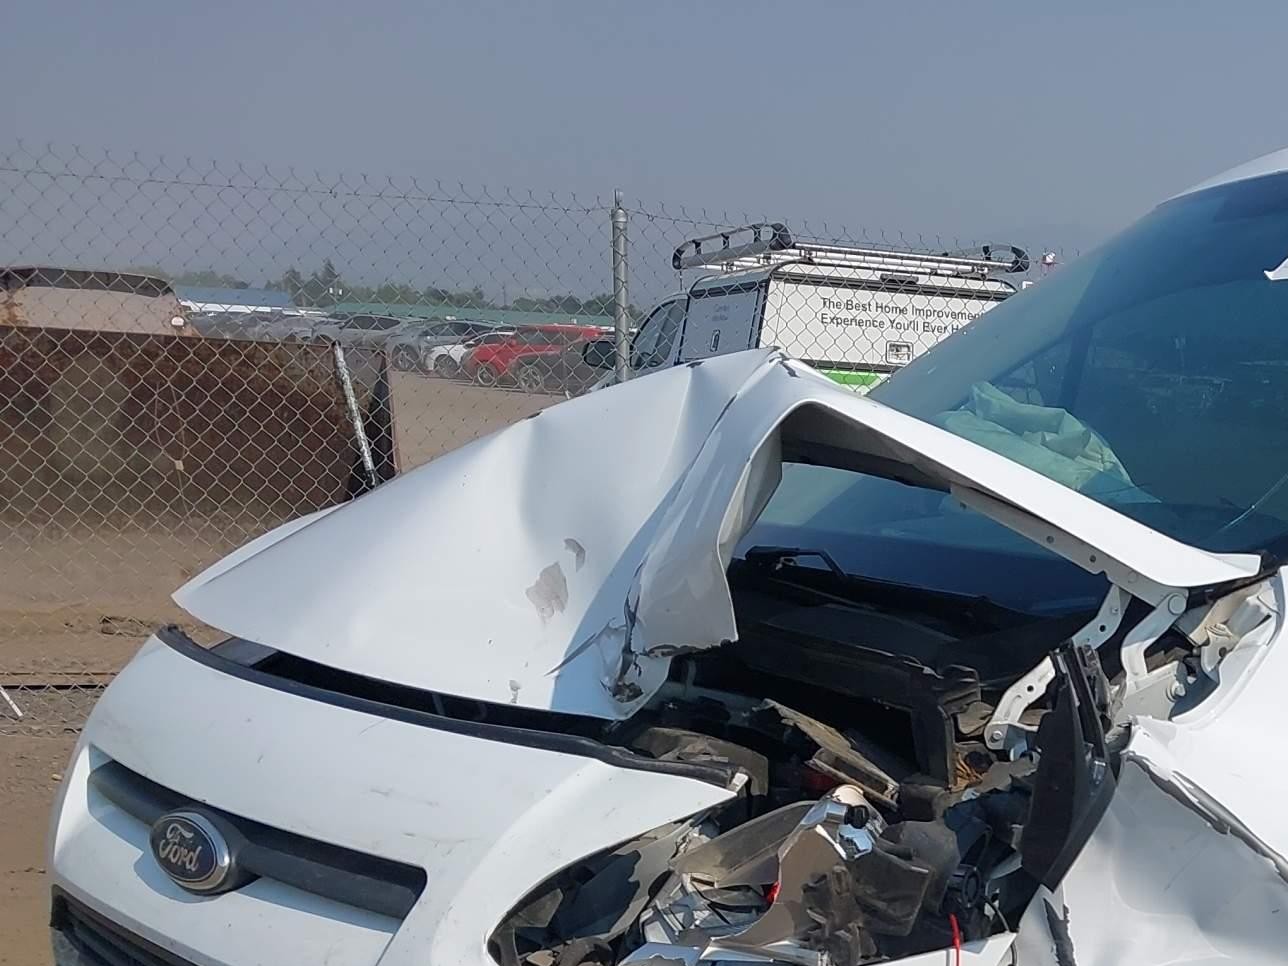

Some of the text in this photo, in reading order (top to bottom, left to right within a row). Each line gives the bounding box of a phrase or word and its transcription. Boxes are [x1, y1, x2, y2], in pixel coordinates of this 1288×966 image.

[822, 298, 842, 310] The
[845, 300, 872, 312] Best
[875, 302, 908, 315] Home
[820, 313, 885, 329] Experience
[889, 319, 920, 331] You'll
[922, 321, 948, 334] Ever
[159, 823, 203, 872] Ford
